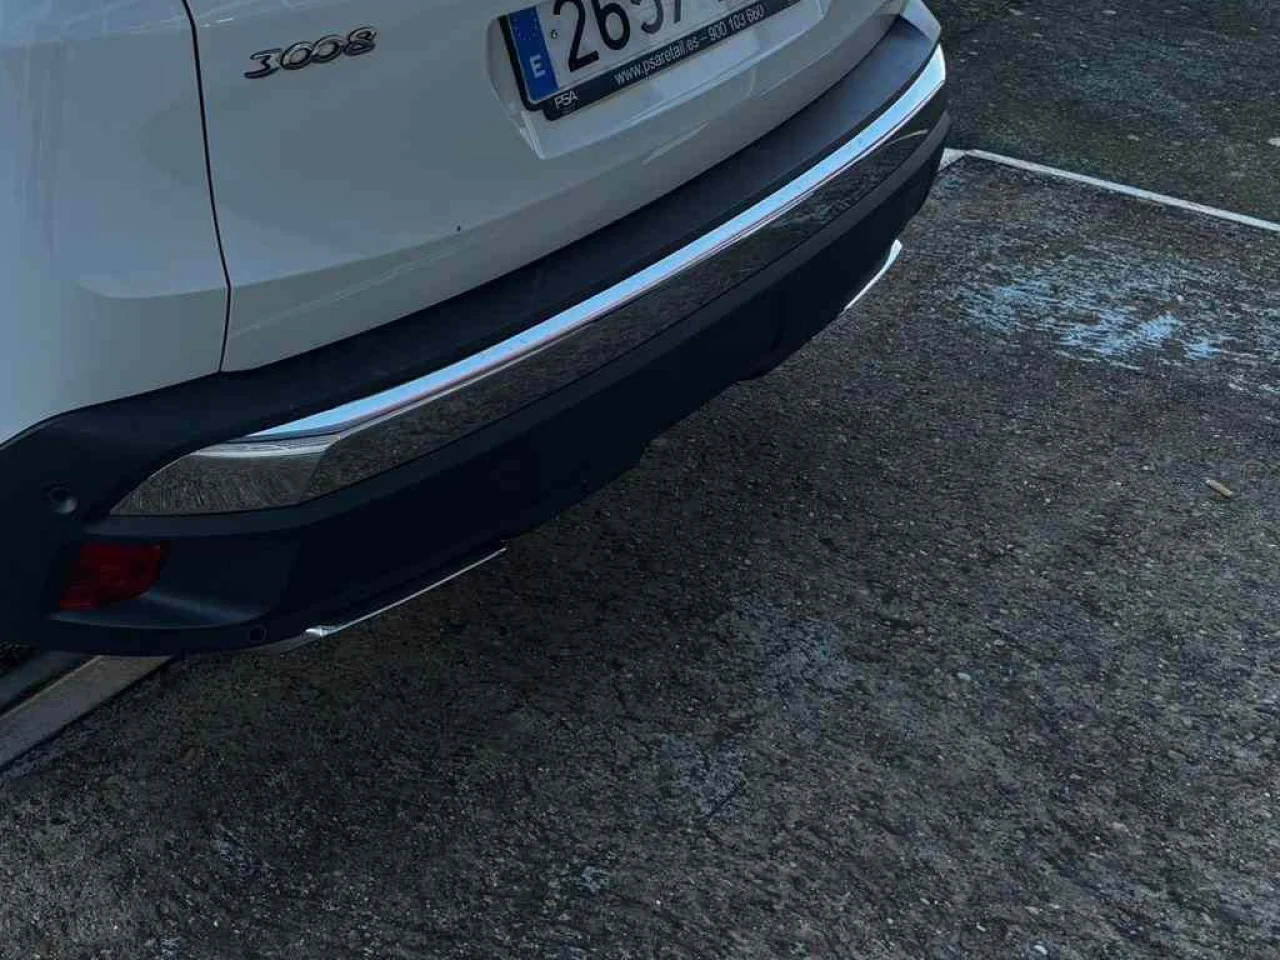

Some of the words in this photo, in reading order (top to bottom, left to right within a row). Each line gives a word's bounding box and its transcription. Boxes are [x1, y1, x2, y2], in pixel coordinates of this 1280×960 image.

[244, 26, 377, 79] 3008
[530, 54, 545, 79] E
[554, 89, 579, 110] PSA
